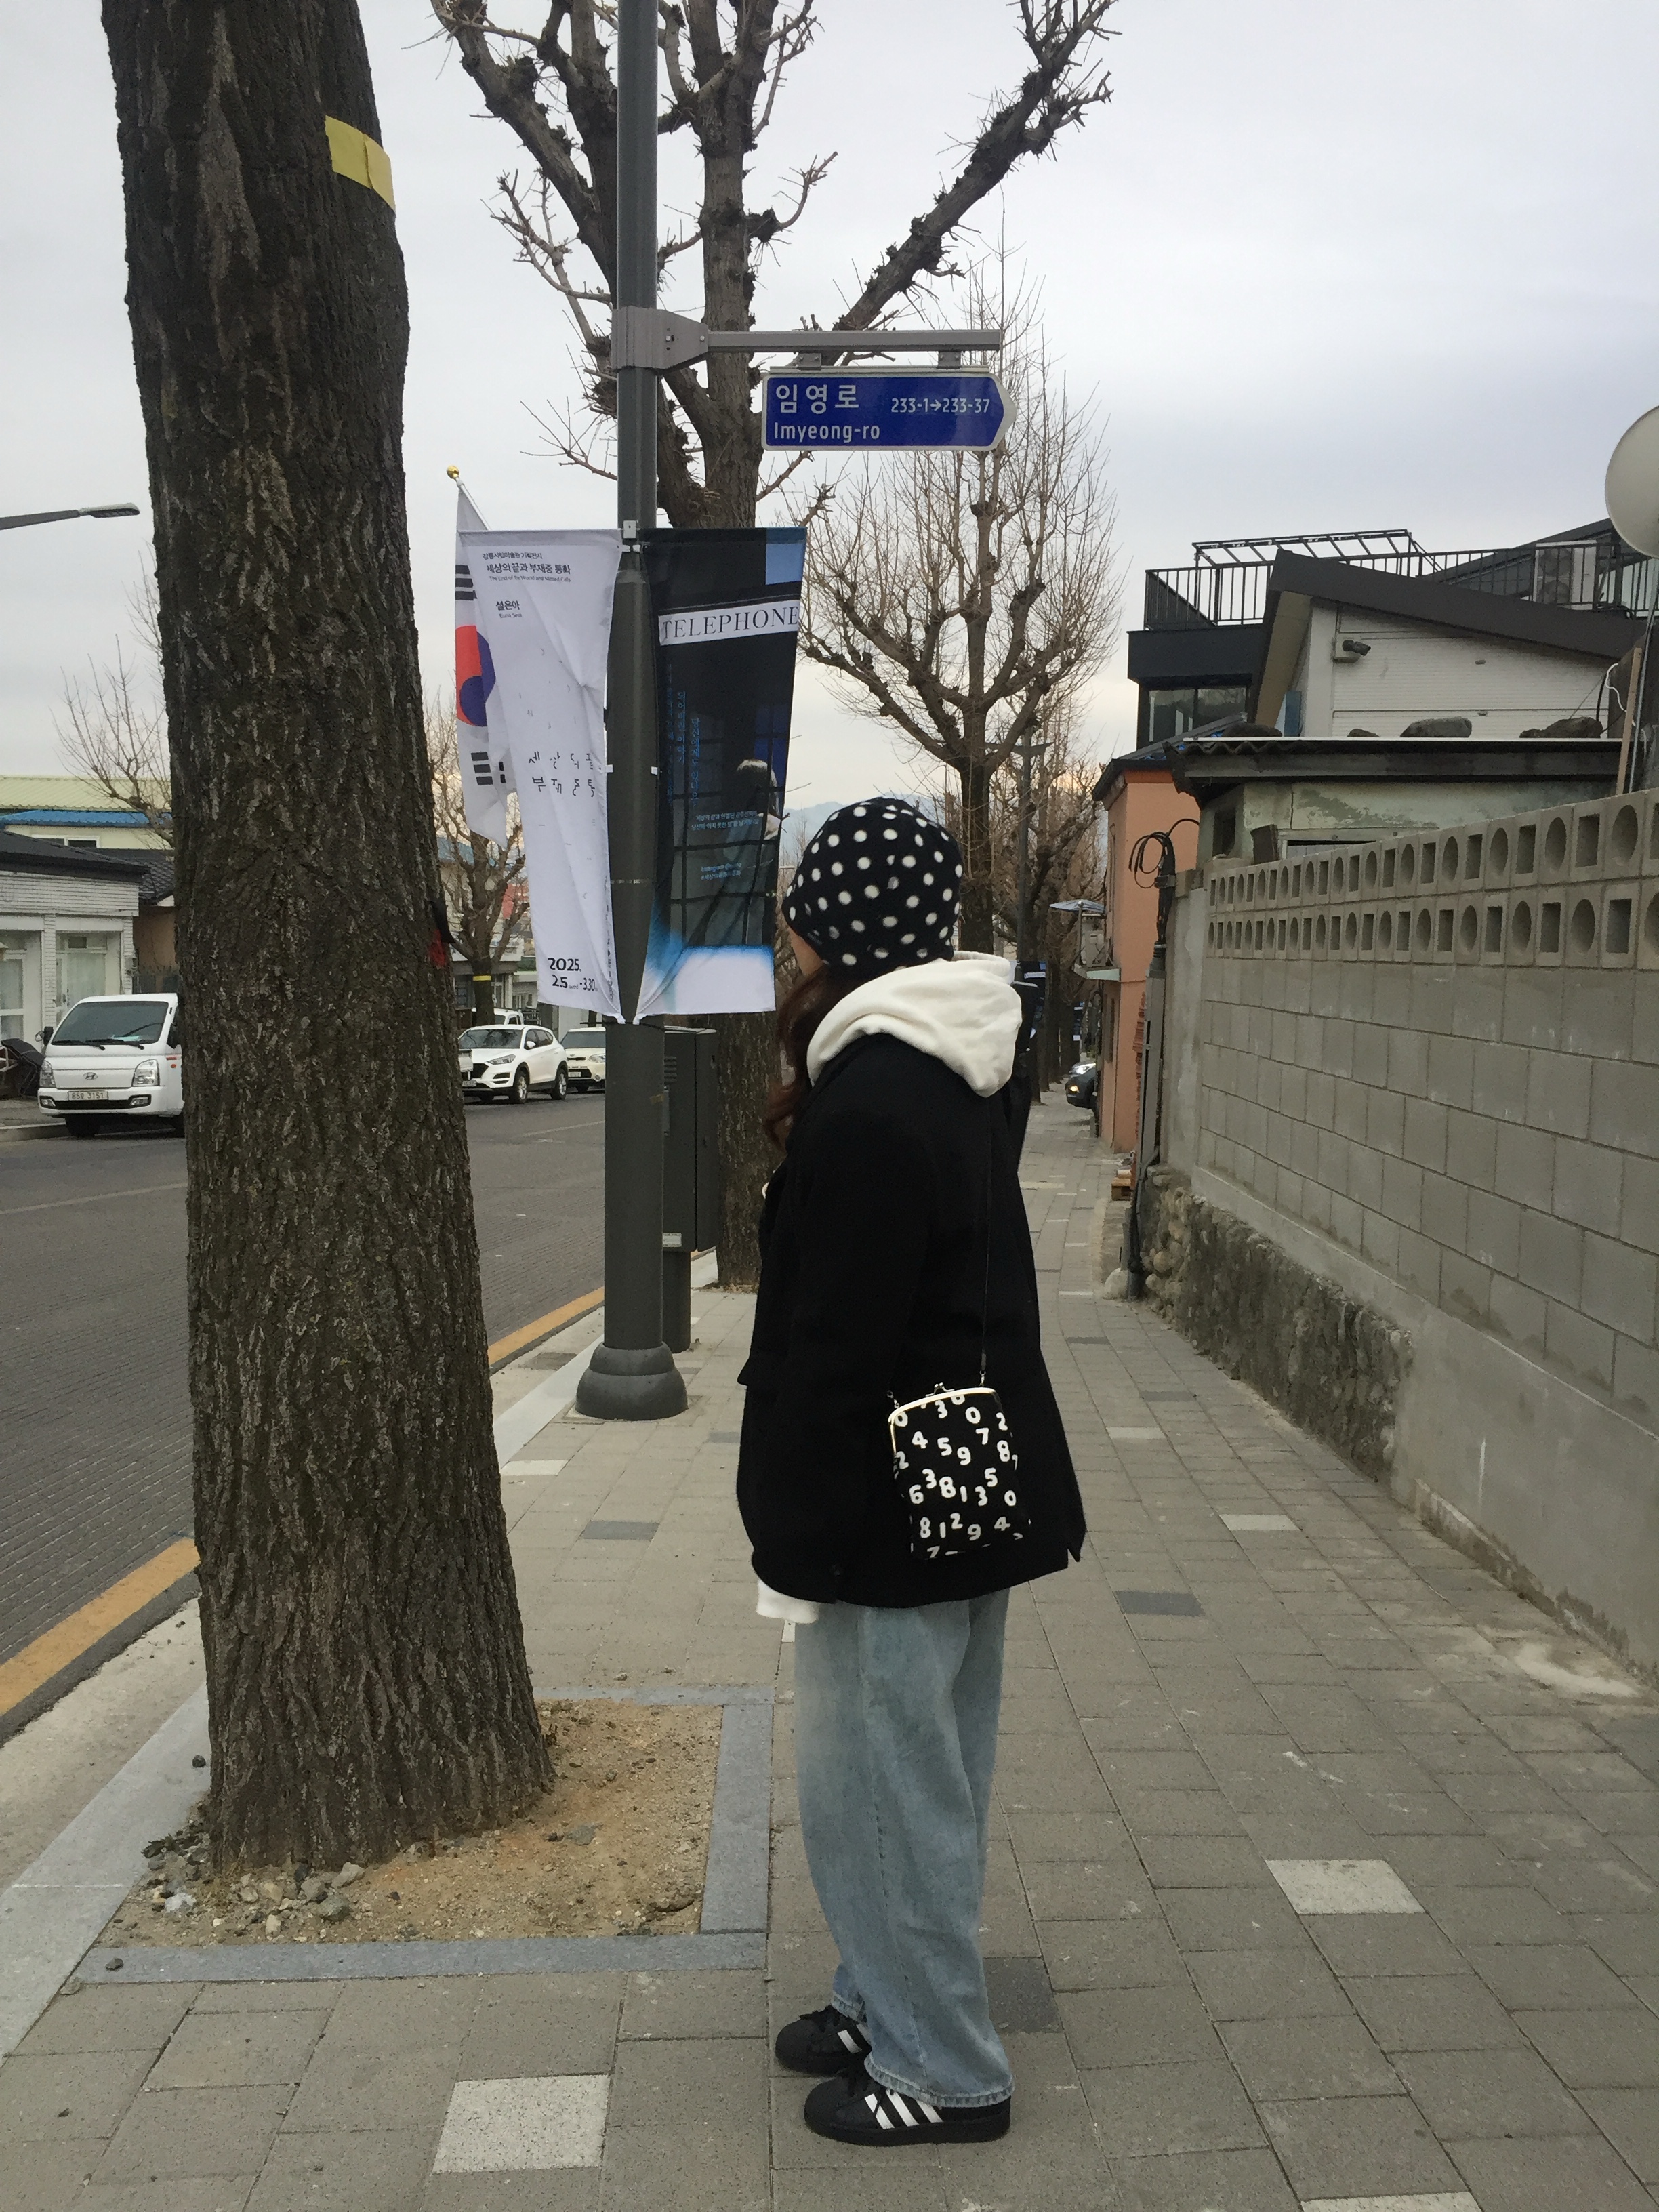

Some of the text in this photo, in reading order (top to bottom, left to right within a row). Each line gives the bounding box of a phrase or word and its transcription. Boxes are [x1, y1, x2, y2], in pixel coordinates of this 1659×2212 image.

[776, 384, 859, 414] 임영로
[942, 398, 990, 413] 233-37
[774, 423, 880, 443] Imyeong-ro
[487, 562, 571, 574] 세상의 끝과 부재중 통화
[495, 600, 520, 611] 설은아
[662, 606, 799, 639] TELEPHONE
[548, 958, 581, 972] 2025.
[965, 1407, 981, 1424] 0
[996, 1412, 1008, 1431] 2
[912, 1431, 928, 1448] 4
[975, 1427, 989, 1445] 7
[937, 1437, 952, 1456] 5
[997, 1440, 1010, 1462] 8
[957, 1447, 971, 1465] 9
[922, 1469, 937, 1489] 3
[985, 1467, 998, 1487] 5
[909, 1485, 924, 1504] 6
[939, 1477, 956, 1498] 8
[960, 1486, 967, 1502] 1
[975, 1486, 987, 1506] 3
[1004, 1490, 1016, 1506] 0
[920, 1517, 931, 1538] 8
[950, 1513, 963, 1529] 2
[994, 1517, 1010, 1531] 4
[968, 1524, 981, 1540] 9
